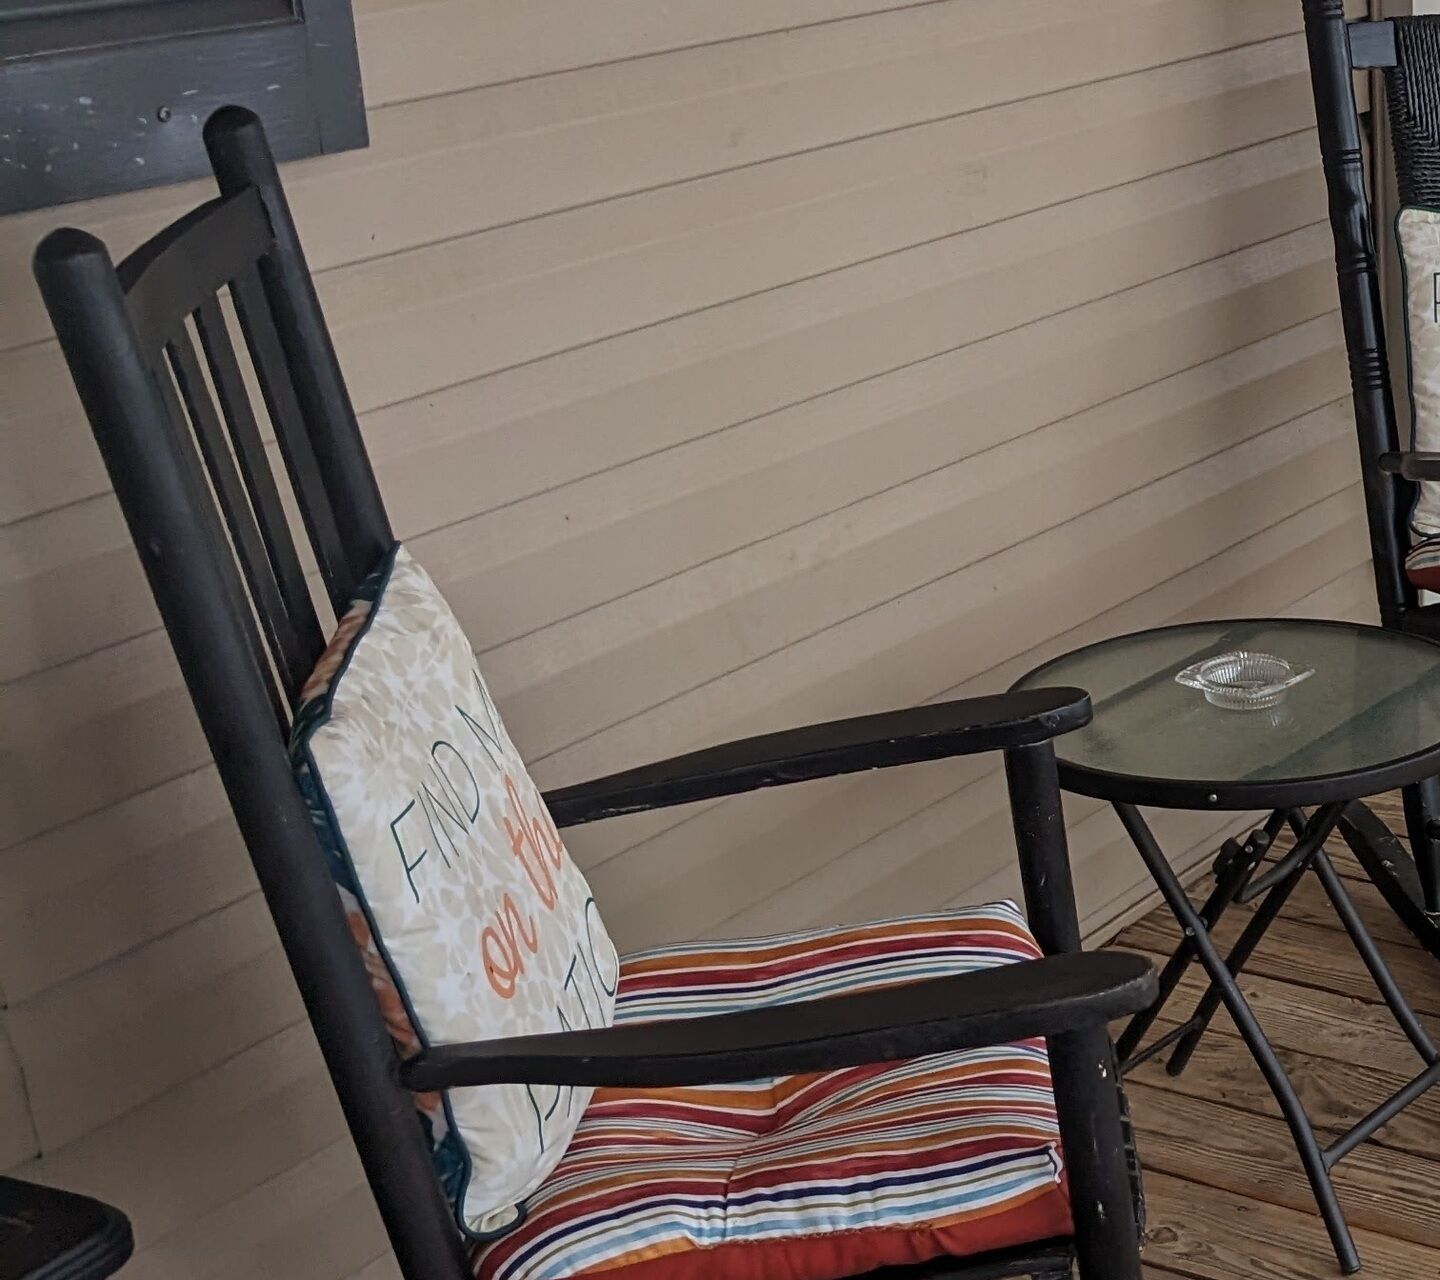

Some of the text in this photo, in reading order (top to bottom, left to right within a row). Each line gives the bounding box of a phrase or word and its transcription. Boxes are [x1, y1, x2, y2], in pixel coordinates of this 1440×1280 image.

[390, 667, 504, 904] FIND M
[481, 774, 563, 1000] on th
